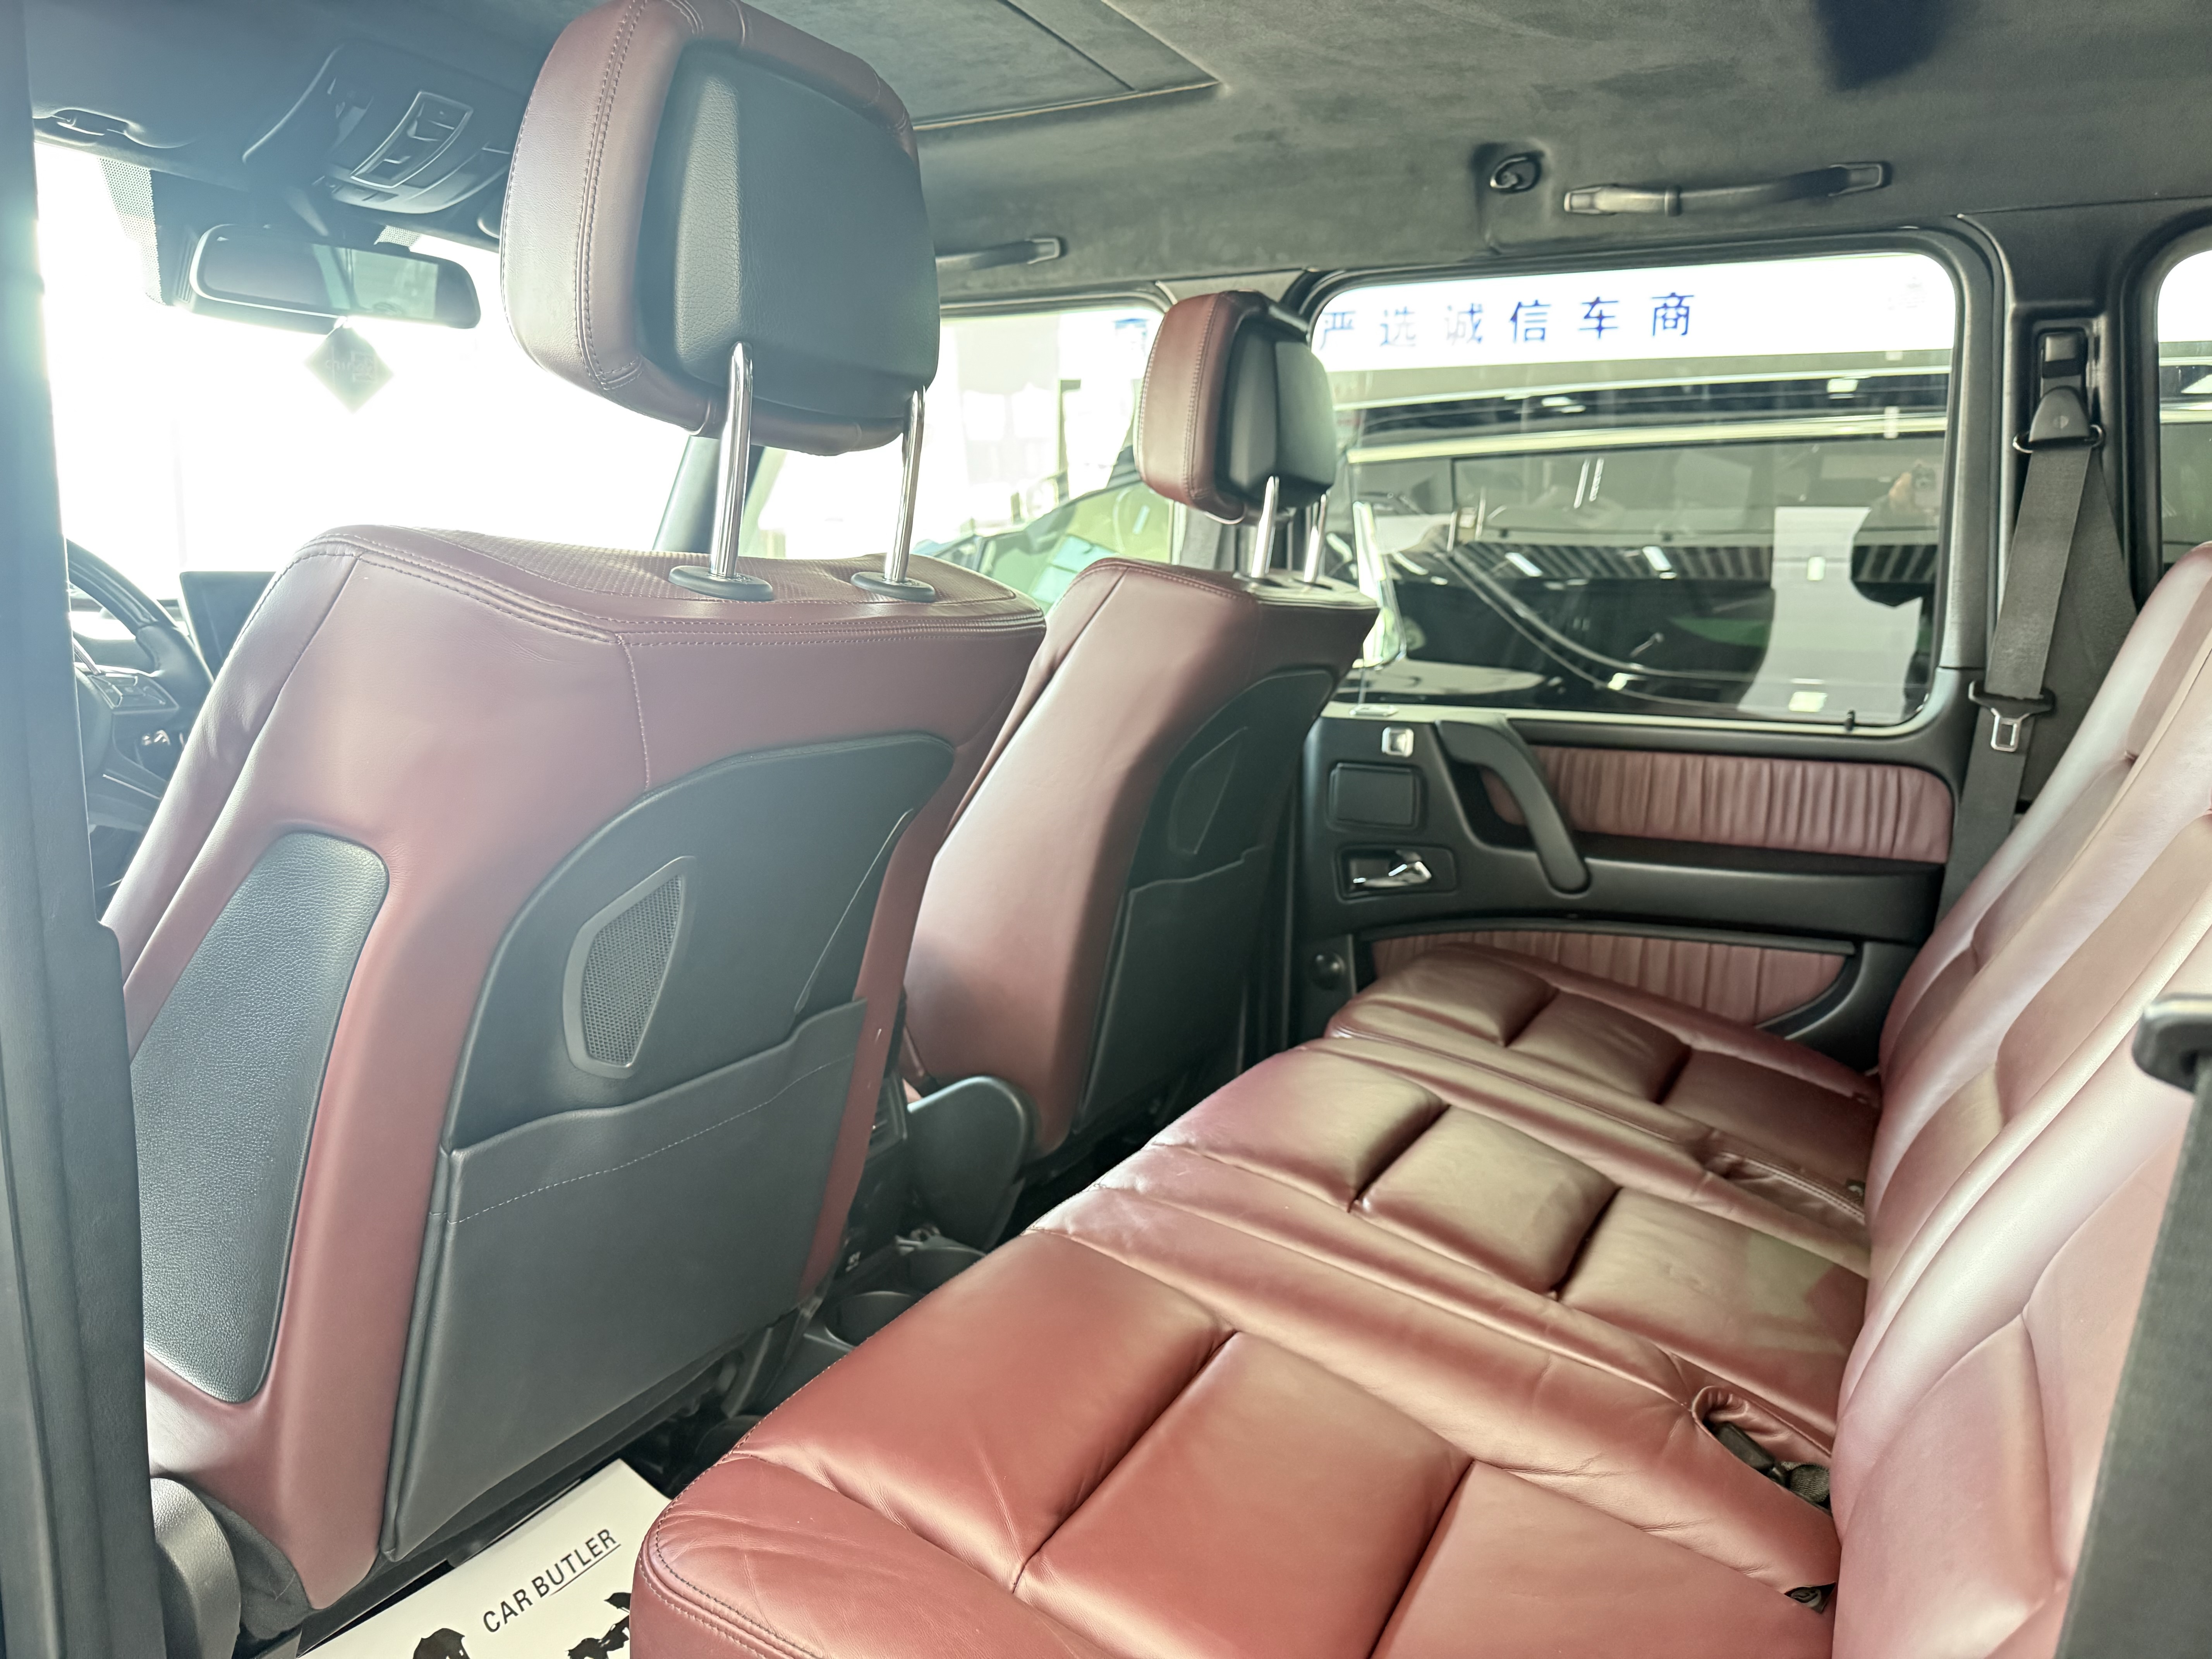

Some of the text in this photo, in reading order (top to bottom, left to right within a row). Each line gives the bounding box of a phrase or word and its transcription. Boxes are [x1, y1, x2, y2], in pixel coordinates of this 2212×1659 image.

[1320, 291, 1695, 350] 严选诚信车商
[483, 1529, 617, 1633] CAR BUTLER
